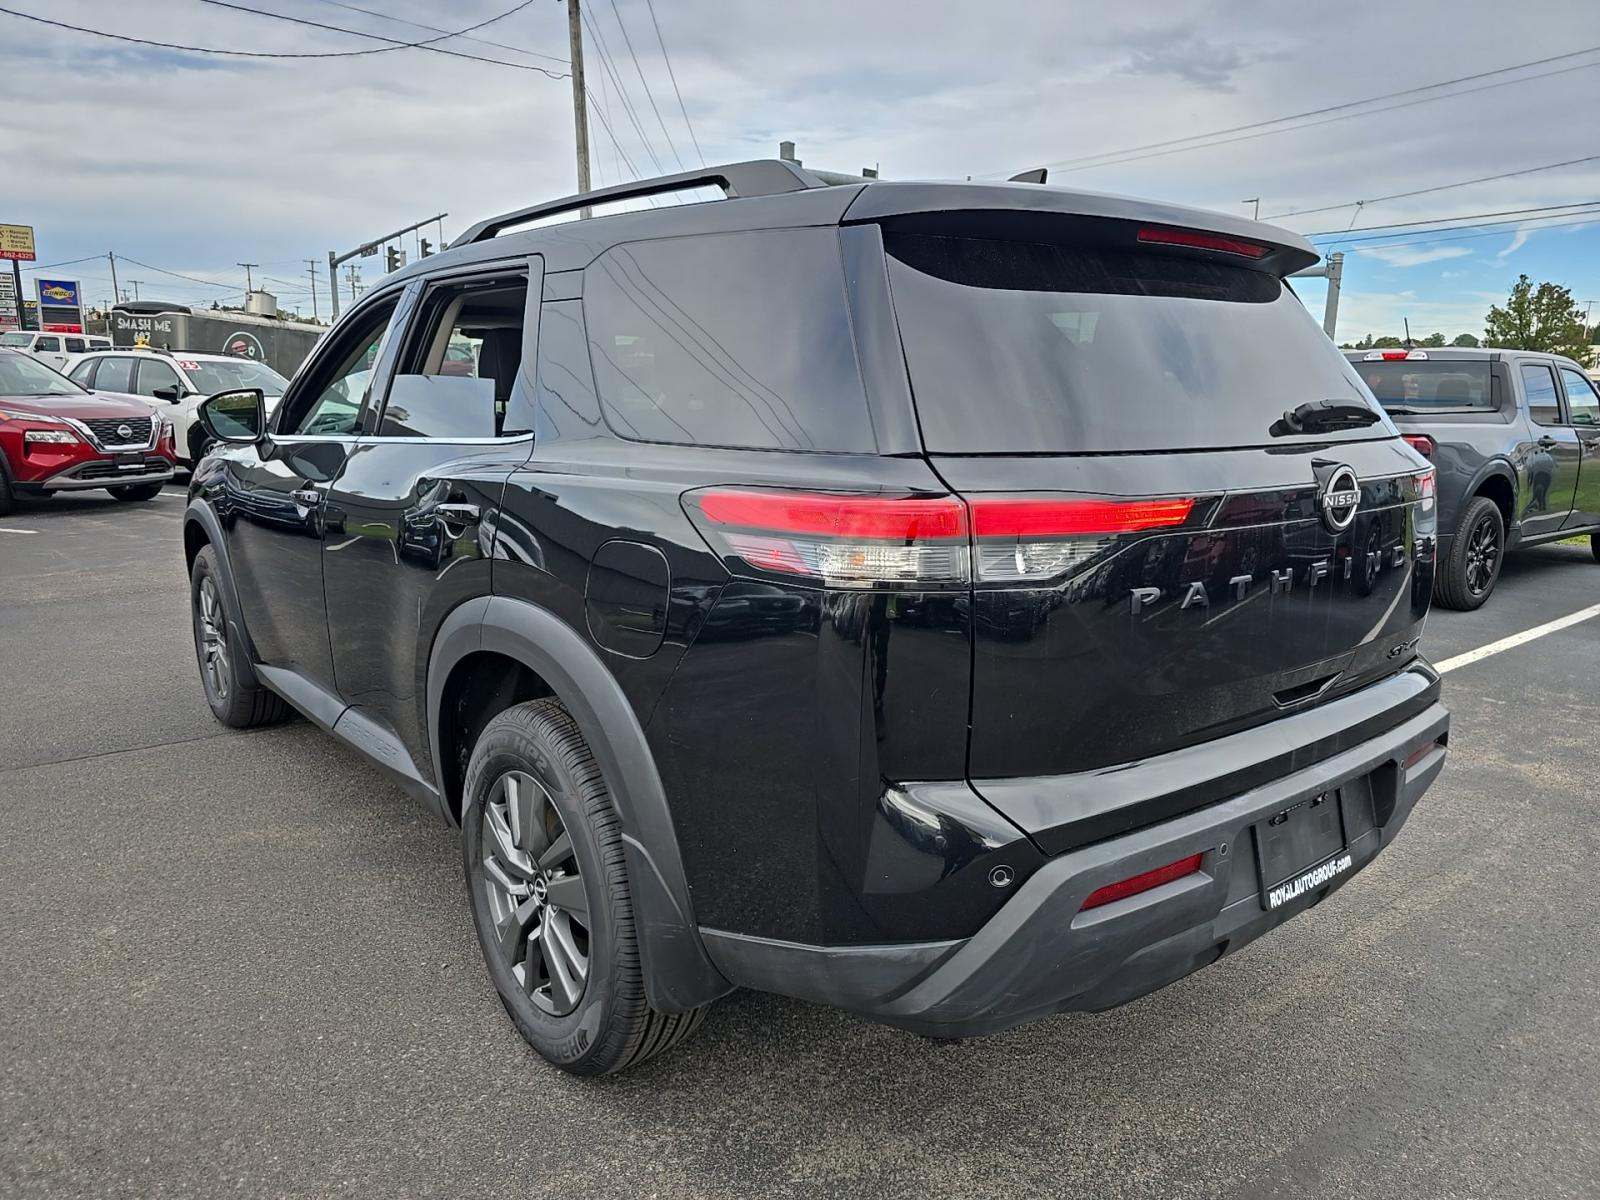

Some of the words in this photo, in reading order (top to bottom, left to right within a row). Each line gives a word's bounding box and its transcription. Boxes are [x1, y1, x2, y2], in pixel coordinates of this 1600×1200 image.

[117, 317, 151, 331] SMASH
[154, 320, 171, 332] ME
[1324, 493, 1360, 507] NISSA
[1129, 534, 1436, 615] PATHFINDE
[1269, 854, 1352, 908] ROYALAUTOGROUP.com
